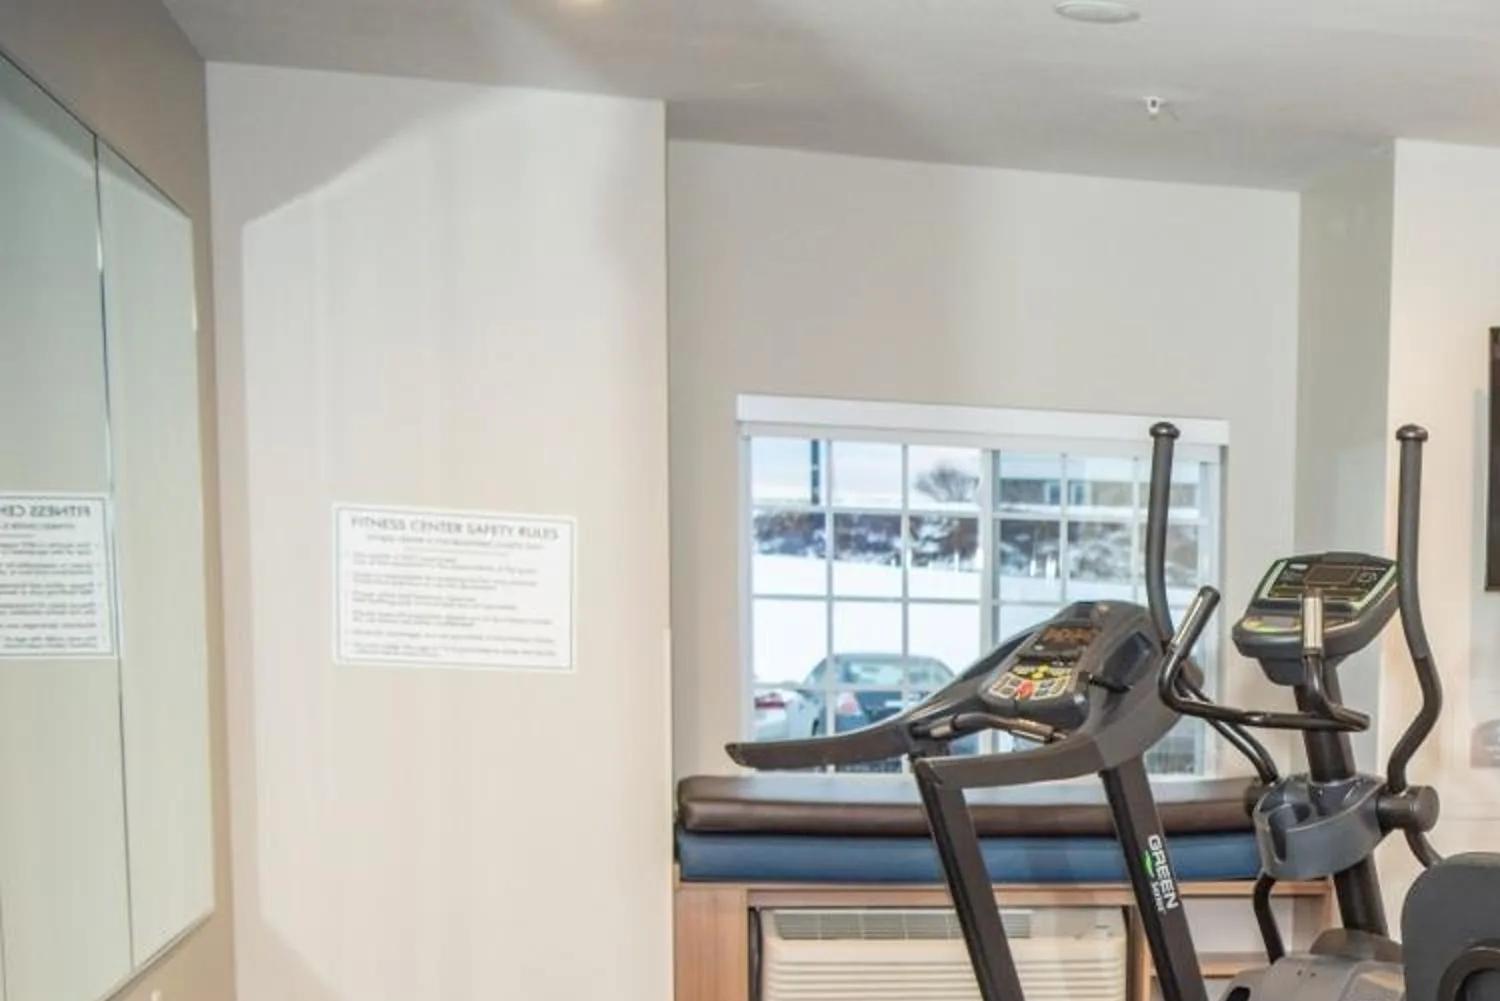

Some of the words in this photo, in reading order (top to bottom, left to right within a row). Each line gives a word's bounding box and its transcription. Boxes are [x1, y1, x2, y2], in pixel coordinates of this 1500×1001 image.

[351, 517, 406, 532] FITNESS
[410, 519, 462, 535] CENTER
[466, 522, 515, 538] SAFETY
[518, 525, 559, 541] RULES
[1148, 834, 1179, 909] GREEN
